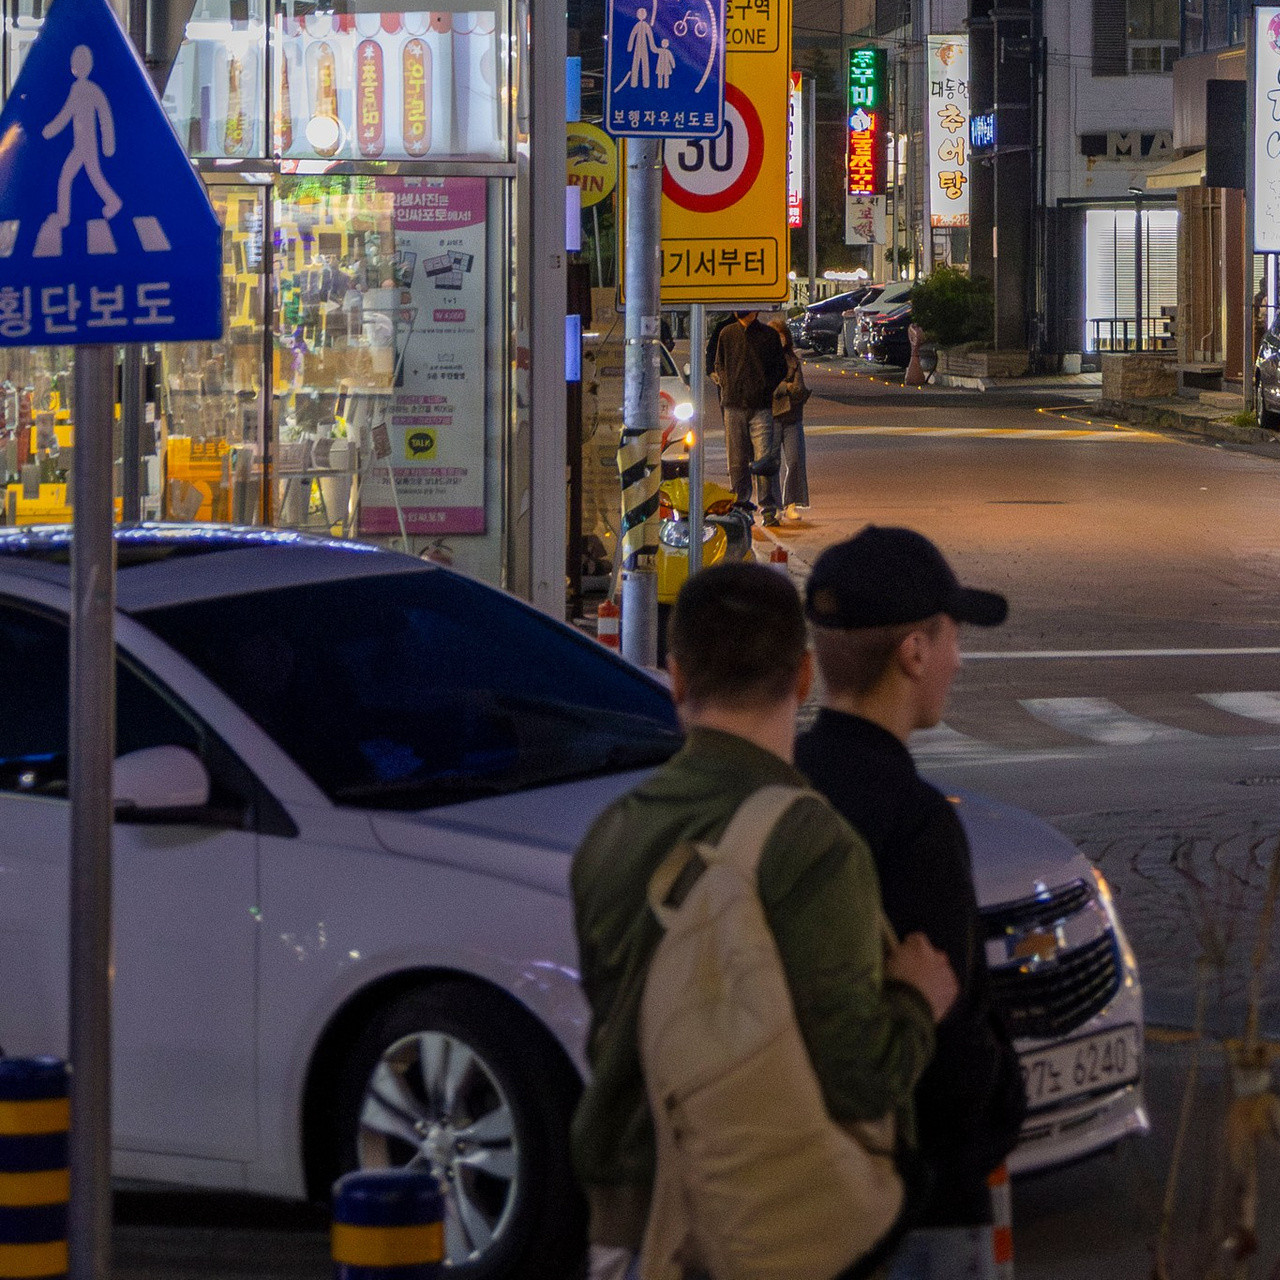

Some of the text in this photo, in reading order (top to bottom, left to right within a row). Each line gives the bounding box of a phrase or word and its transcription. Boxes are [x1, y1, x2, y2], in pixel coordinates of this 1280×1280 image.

[612, 109, 716, 129] 보행자우선도로
[677, 120, 734, 172] 30
[936, 103, 968, 200] 추어탕
[660, 247, 765, 278] 기서부터
[0, 281, 176, 338] 횡단보도
